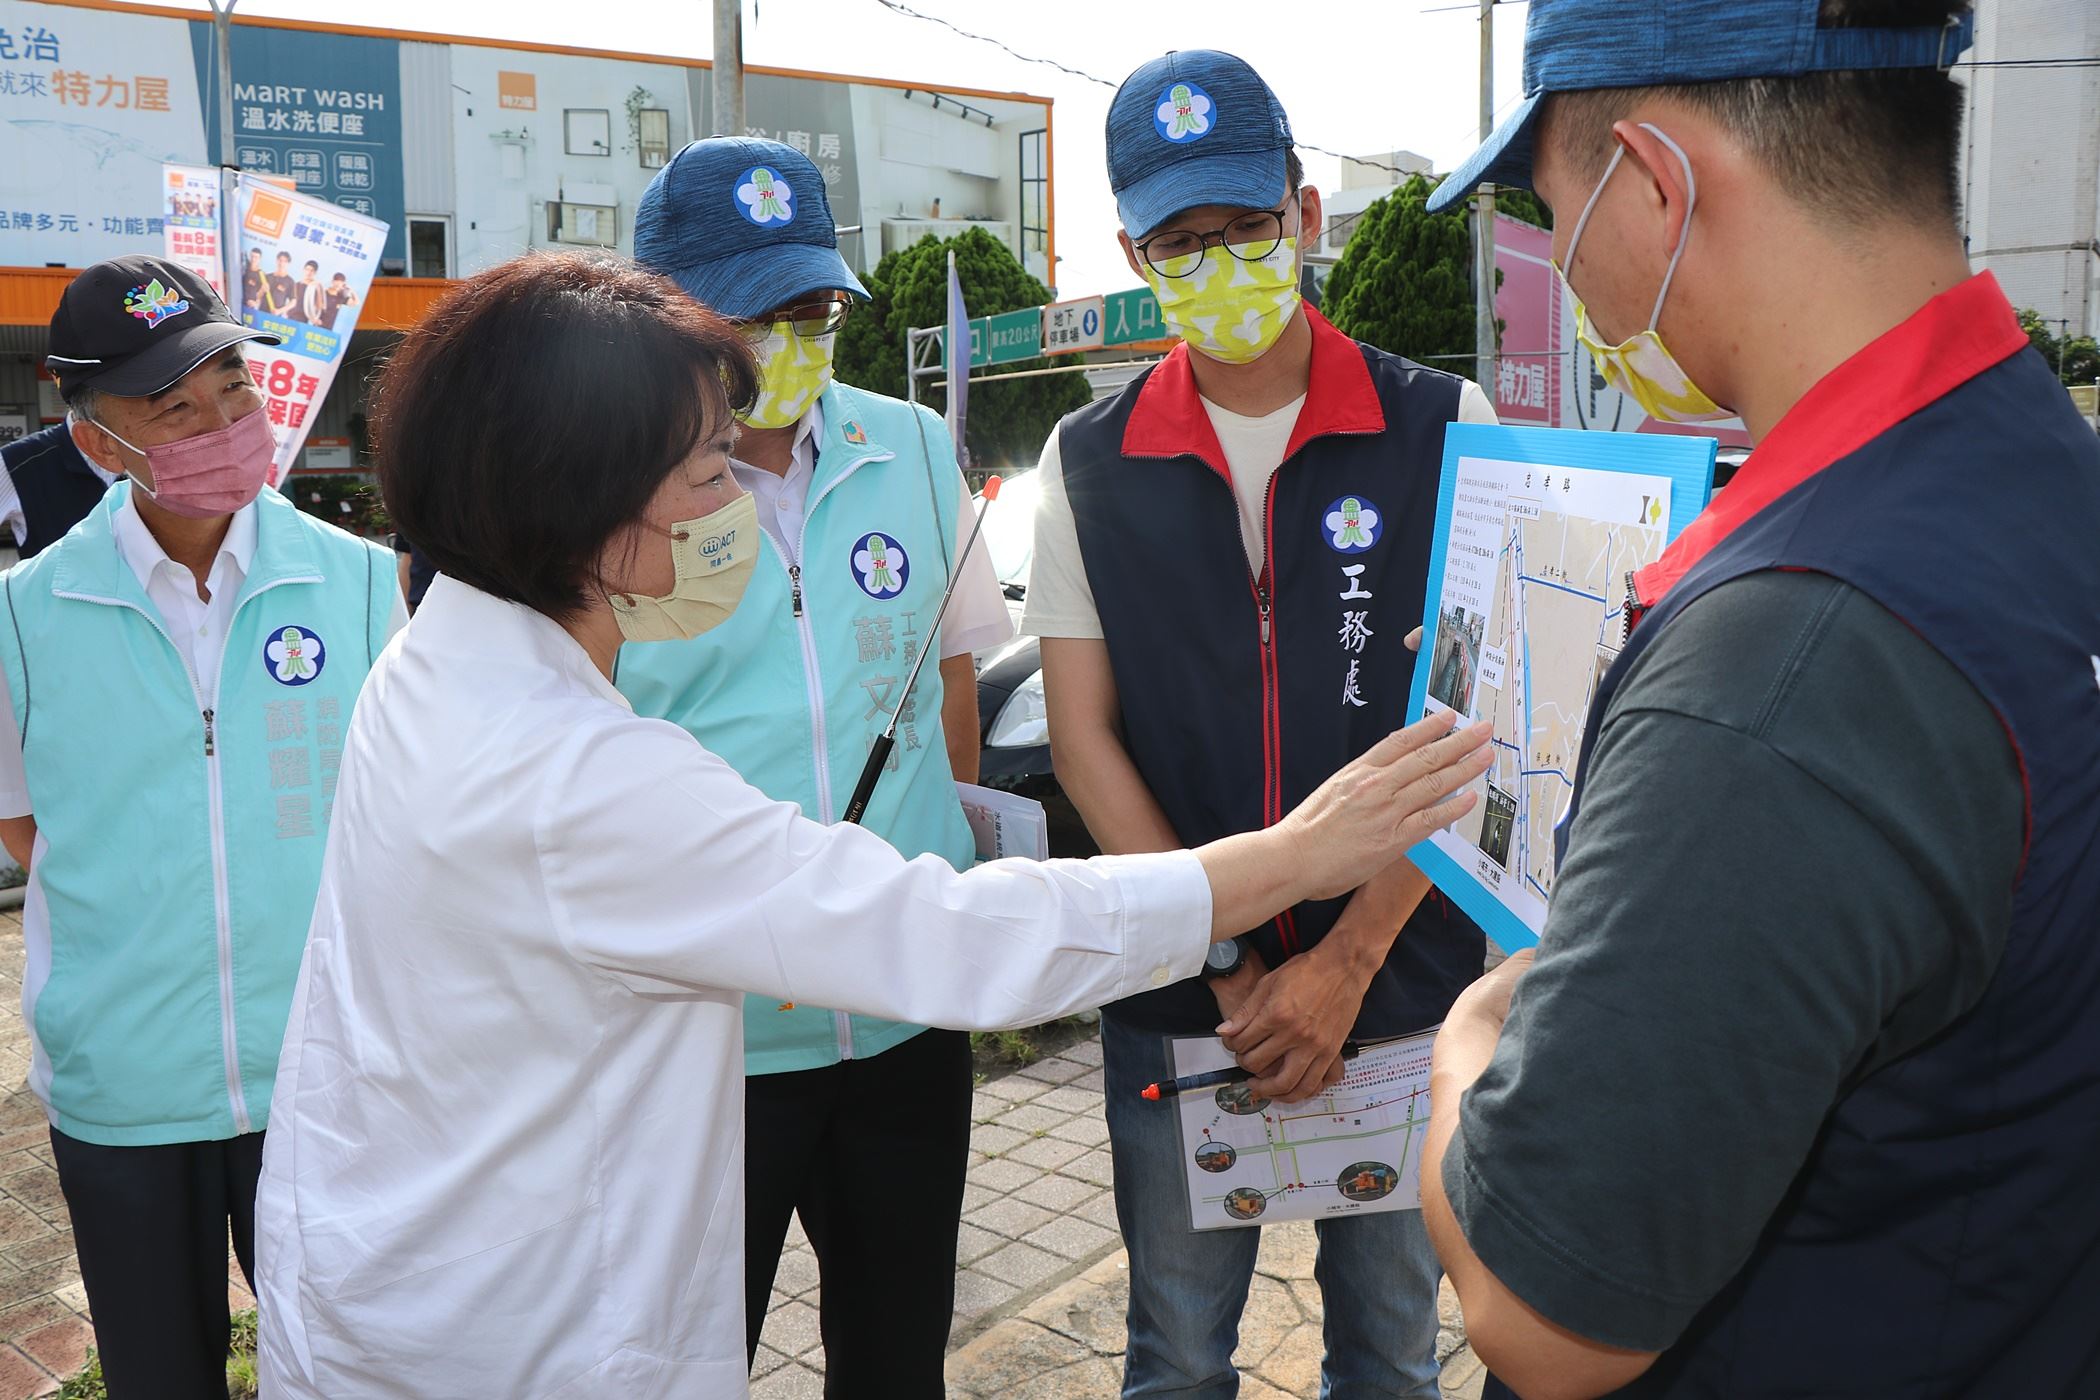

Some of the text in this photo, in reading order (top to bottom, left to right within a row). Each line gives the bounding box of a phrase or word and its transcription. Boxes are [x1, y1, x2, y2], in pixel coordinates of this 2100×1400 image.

[1054, 308, 1074, 326] 地下
[1113, 297, 1157, 338] 入口
[1050, 326, 1080, 346] 停車場
[1500, 358, 1545, 408] 特力屋
[720, 529, 736, 549] ACT
[1337, 563, 1375, 707] 工務處
